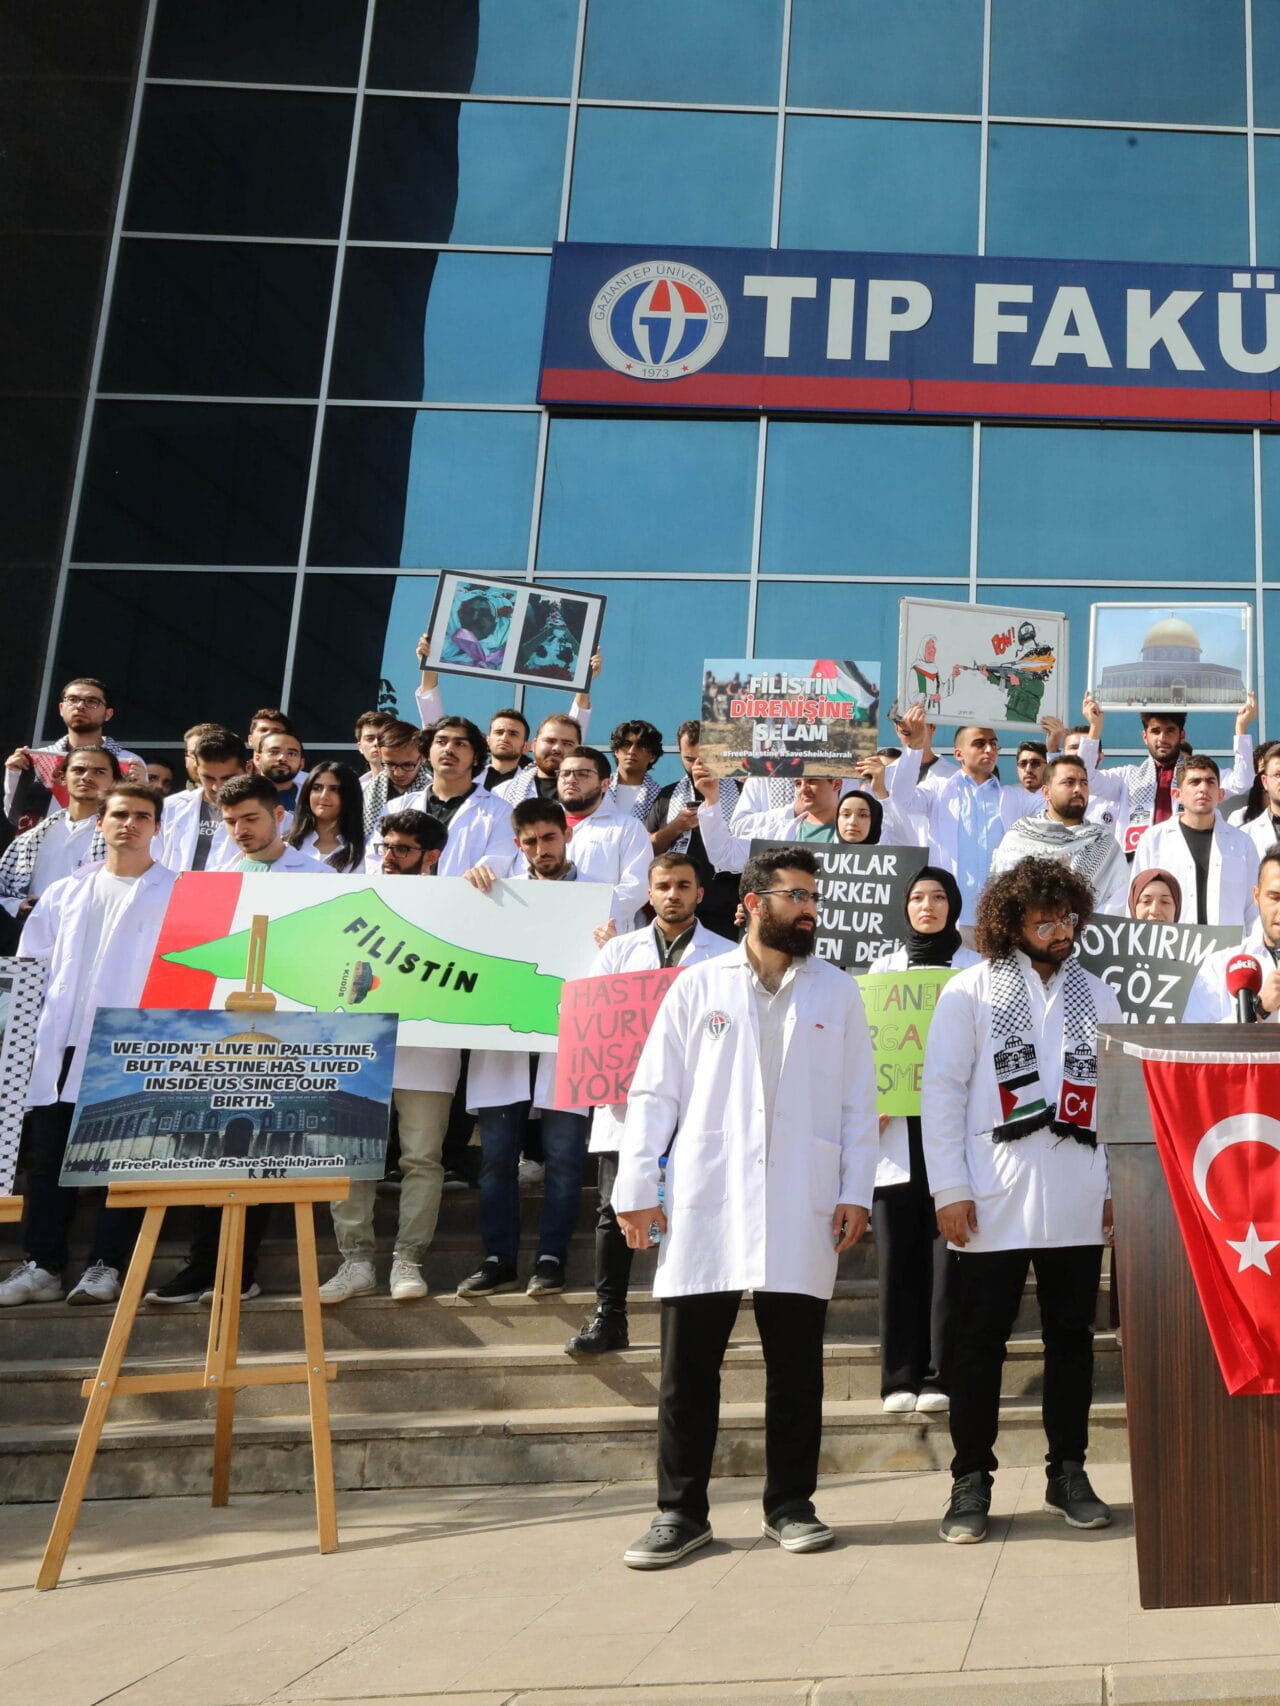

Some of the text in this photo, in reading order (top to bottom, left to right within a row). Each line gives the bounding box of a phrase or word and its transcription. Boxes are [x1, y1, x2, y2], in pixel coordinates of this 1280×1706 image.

[743, 275, 933, 361] TIP
[642, 368, 669, 377] 1973
[750, 671, 838, 694] FİLİSTİN
[730, 694, 854, 724] DİRENİŞİNE
[756, 723, 828, 741] SELAM
[814, 879, 891, 905] URKEN
[342, 916, 479, 993] FİLİSTİN
[1100, 962, 1182, 1009] GÖZ
[112, 1042, 376, 1058] WE DIDN'T LIVE IN PALESTINE,
[125, 1060, 360, 1073] BUT PALESTINE HAS LIVED
[145, 1077, 337, 1090] INSIDE US SINCE OUR
[212, 1095, 273, 1108] BIRTH.
[111, 1156, 344, 1170] #FreePalestine #SaveSheikhJarrah
